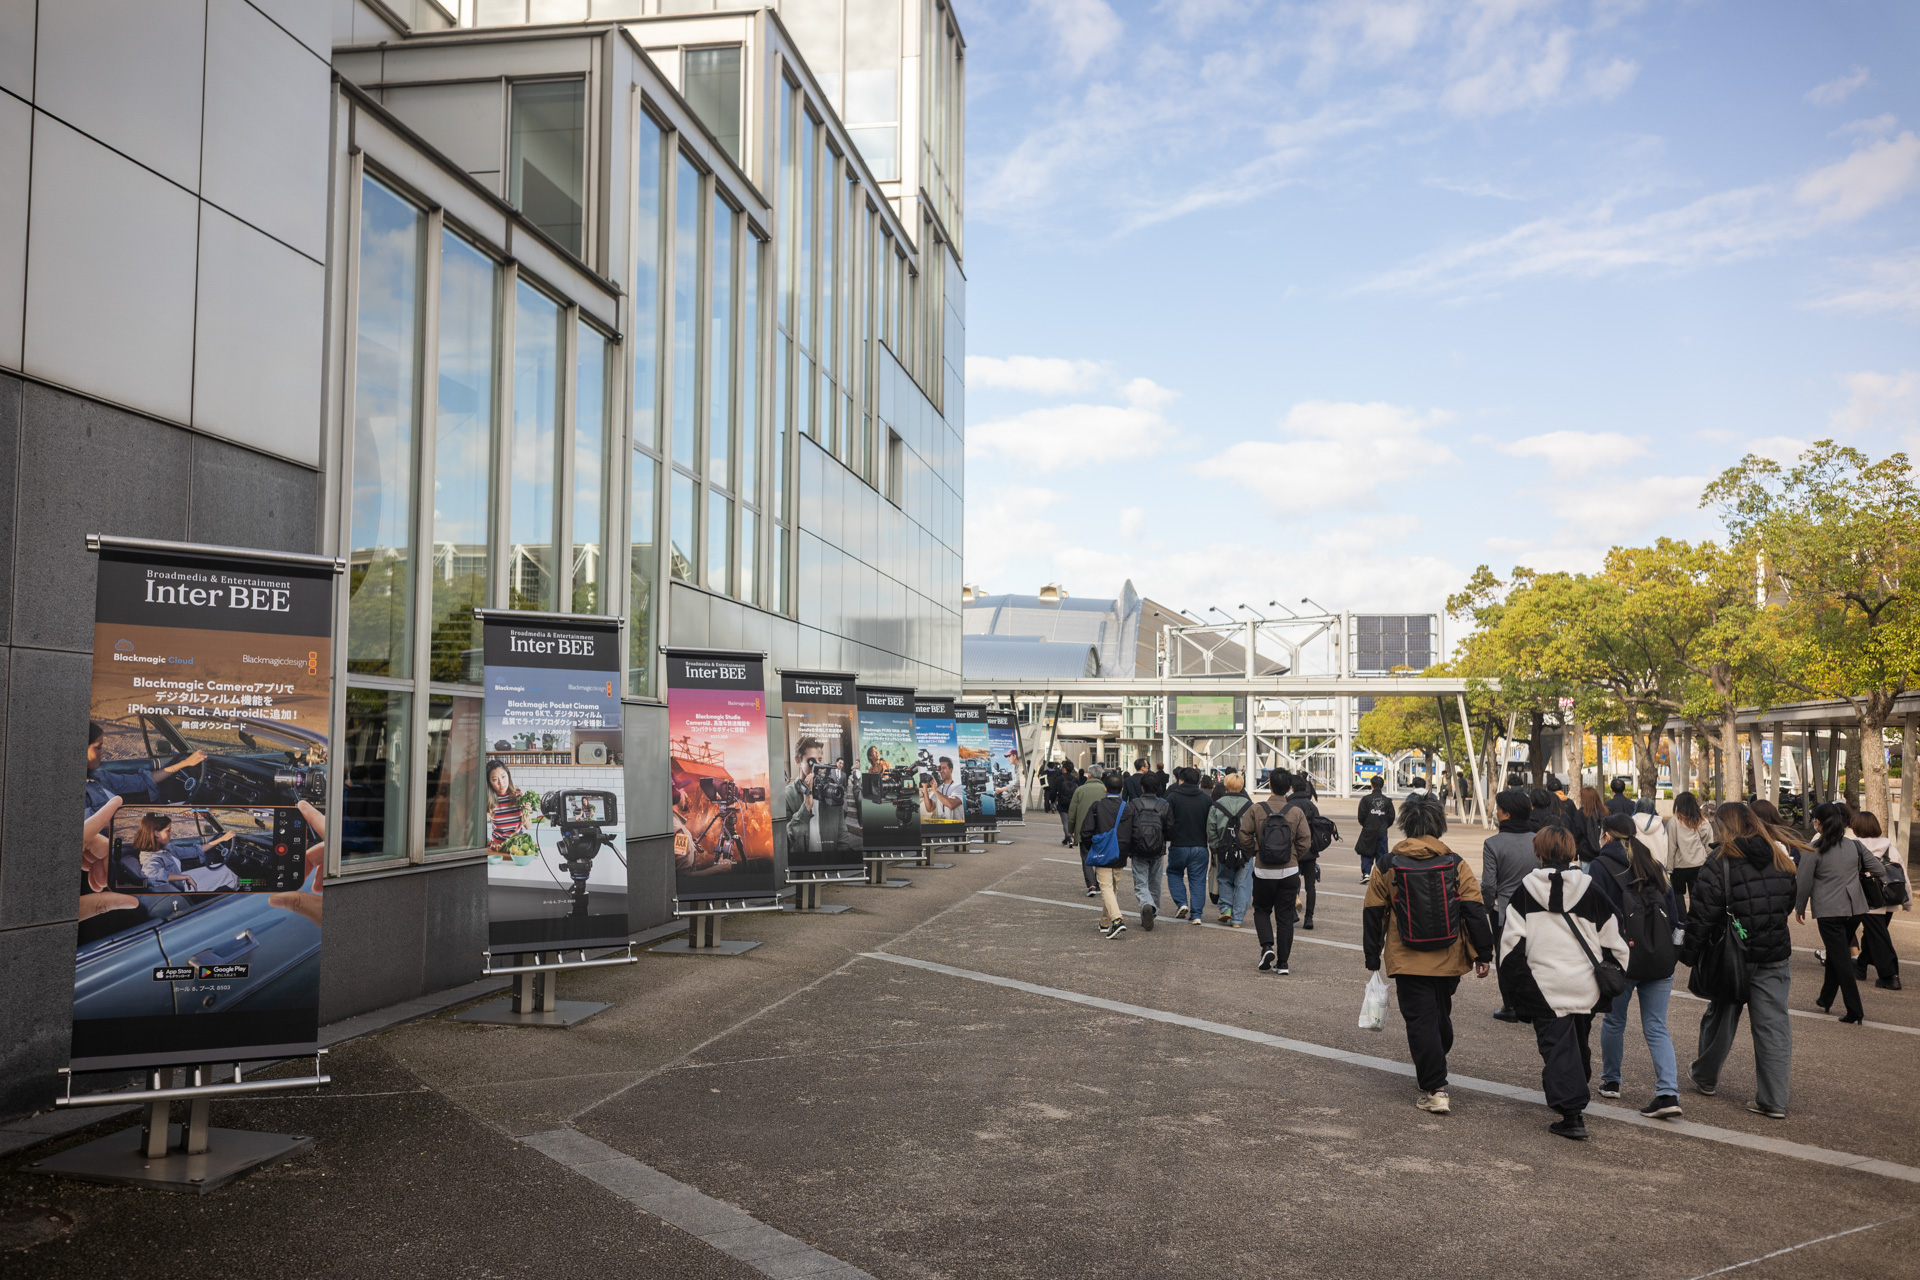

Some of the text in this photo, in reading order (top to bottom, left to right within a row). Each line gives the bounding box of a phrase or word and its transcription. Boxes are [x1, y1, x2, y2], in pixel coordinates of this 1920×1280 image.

[147, 570, 207, 582] Broadmedia
[221, 576, 290, 589] Entertainment
[145, 579, 290, 612] Inter BEE
[510, 636, 594, 656] Inter BEE
[113, 653, 194, 665] Blackmagic Cloud
[242, 654, 307, 668] Blackmagicdesign
[686, 666, 746, 680] Inter BEE
[133, 677, 295, 694] Blackmagic Cameraアプリで
[796, 684, 842, 696] Inter BEE
[155, 691, 273, 707] デジタルフィルム機能を
[508, 700, 548, 709] Blackmagic
[866, 697, 904, 706] Inter BEE
[182, 721, 246, 731] 無償ダウンロード
